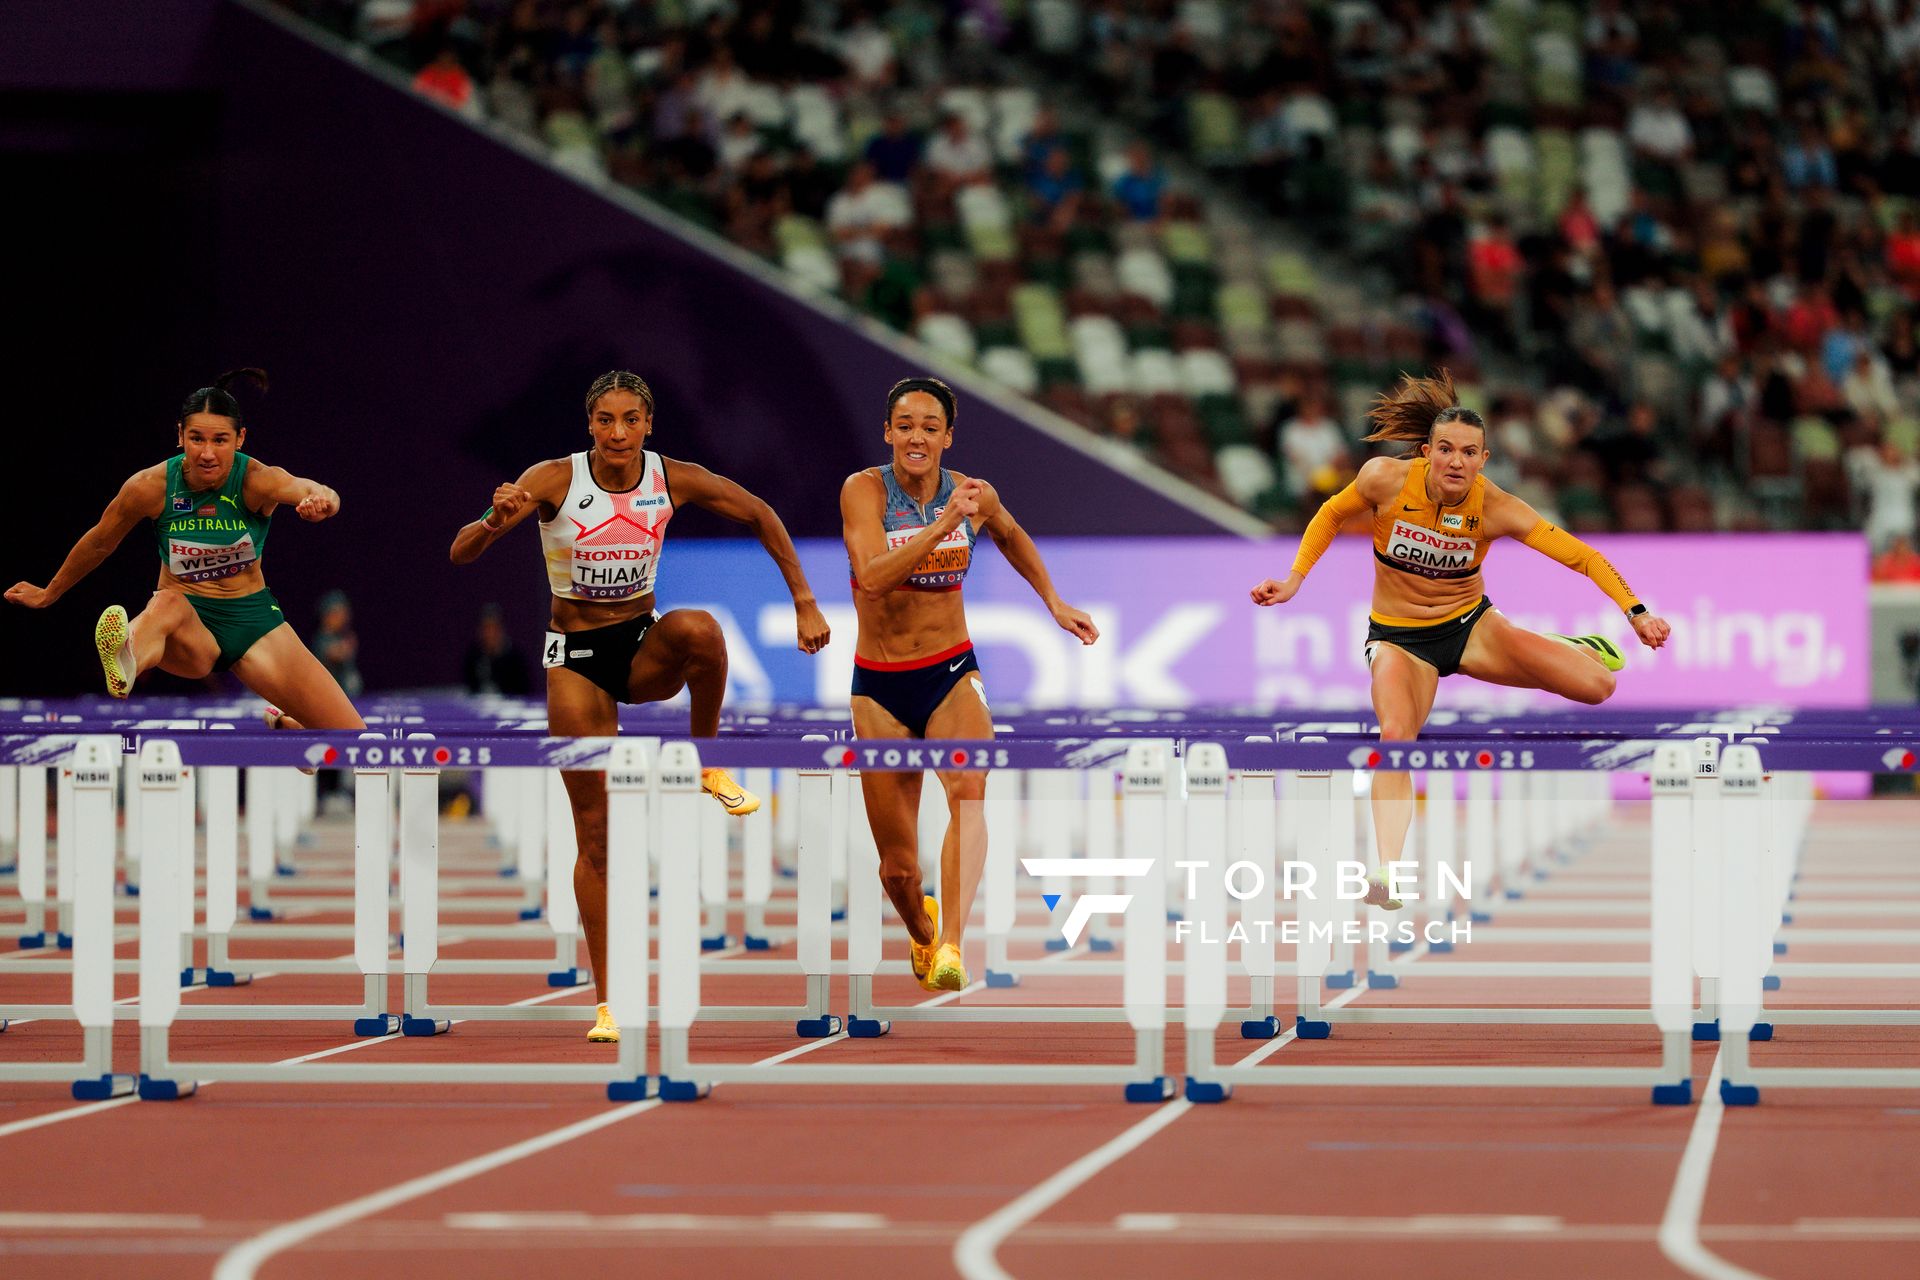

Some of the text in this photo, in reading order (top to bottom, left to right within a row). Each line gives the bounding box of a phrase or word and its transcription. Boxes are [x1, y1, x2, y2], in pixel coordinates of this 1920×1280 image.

[635, 499, 657, 507] Allianz
[169, 518, 247, 532] AUSTRALIA
[1443, 516, 1462, 526] WGV
[1394, 524, 1474, 550] HONDA
[171, 541, 252, 557] HONDA
[574, 549, 653, 561] HONDA
[1392, 543, 1468, 568] GRIMM
[180, 551, 244, 571] WEST
[577, 563, 647, 584] THIAM
[547, 640, 558, 663] 4
[76, 773, 109, 782] NISHI
[143, 773, 177, 782] NISHI
